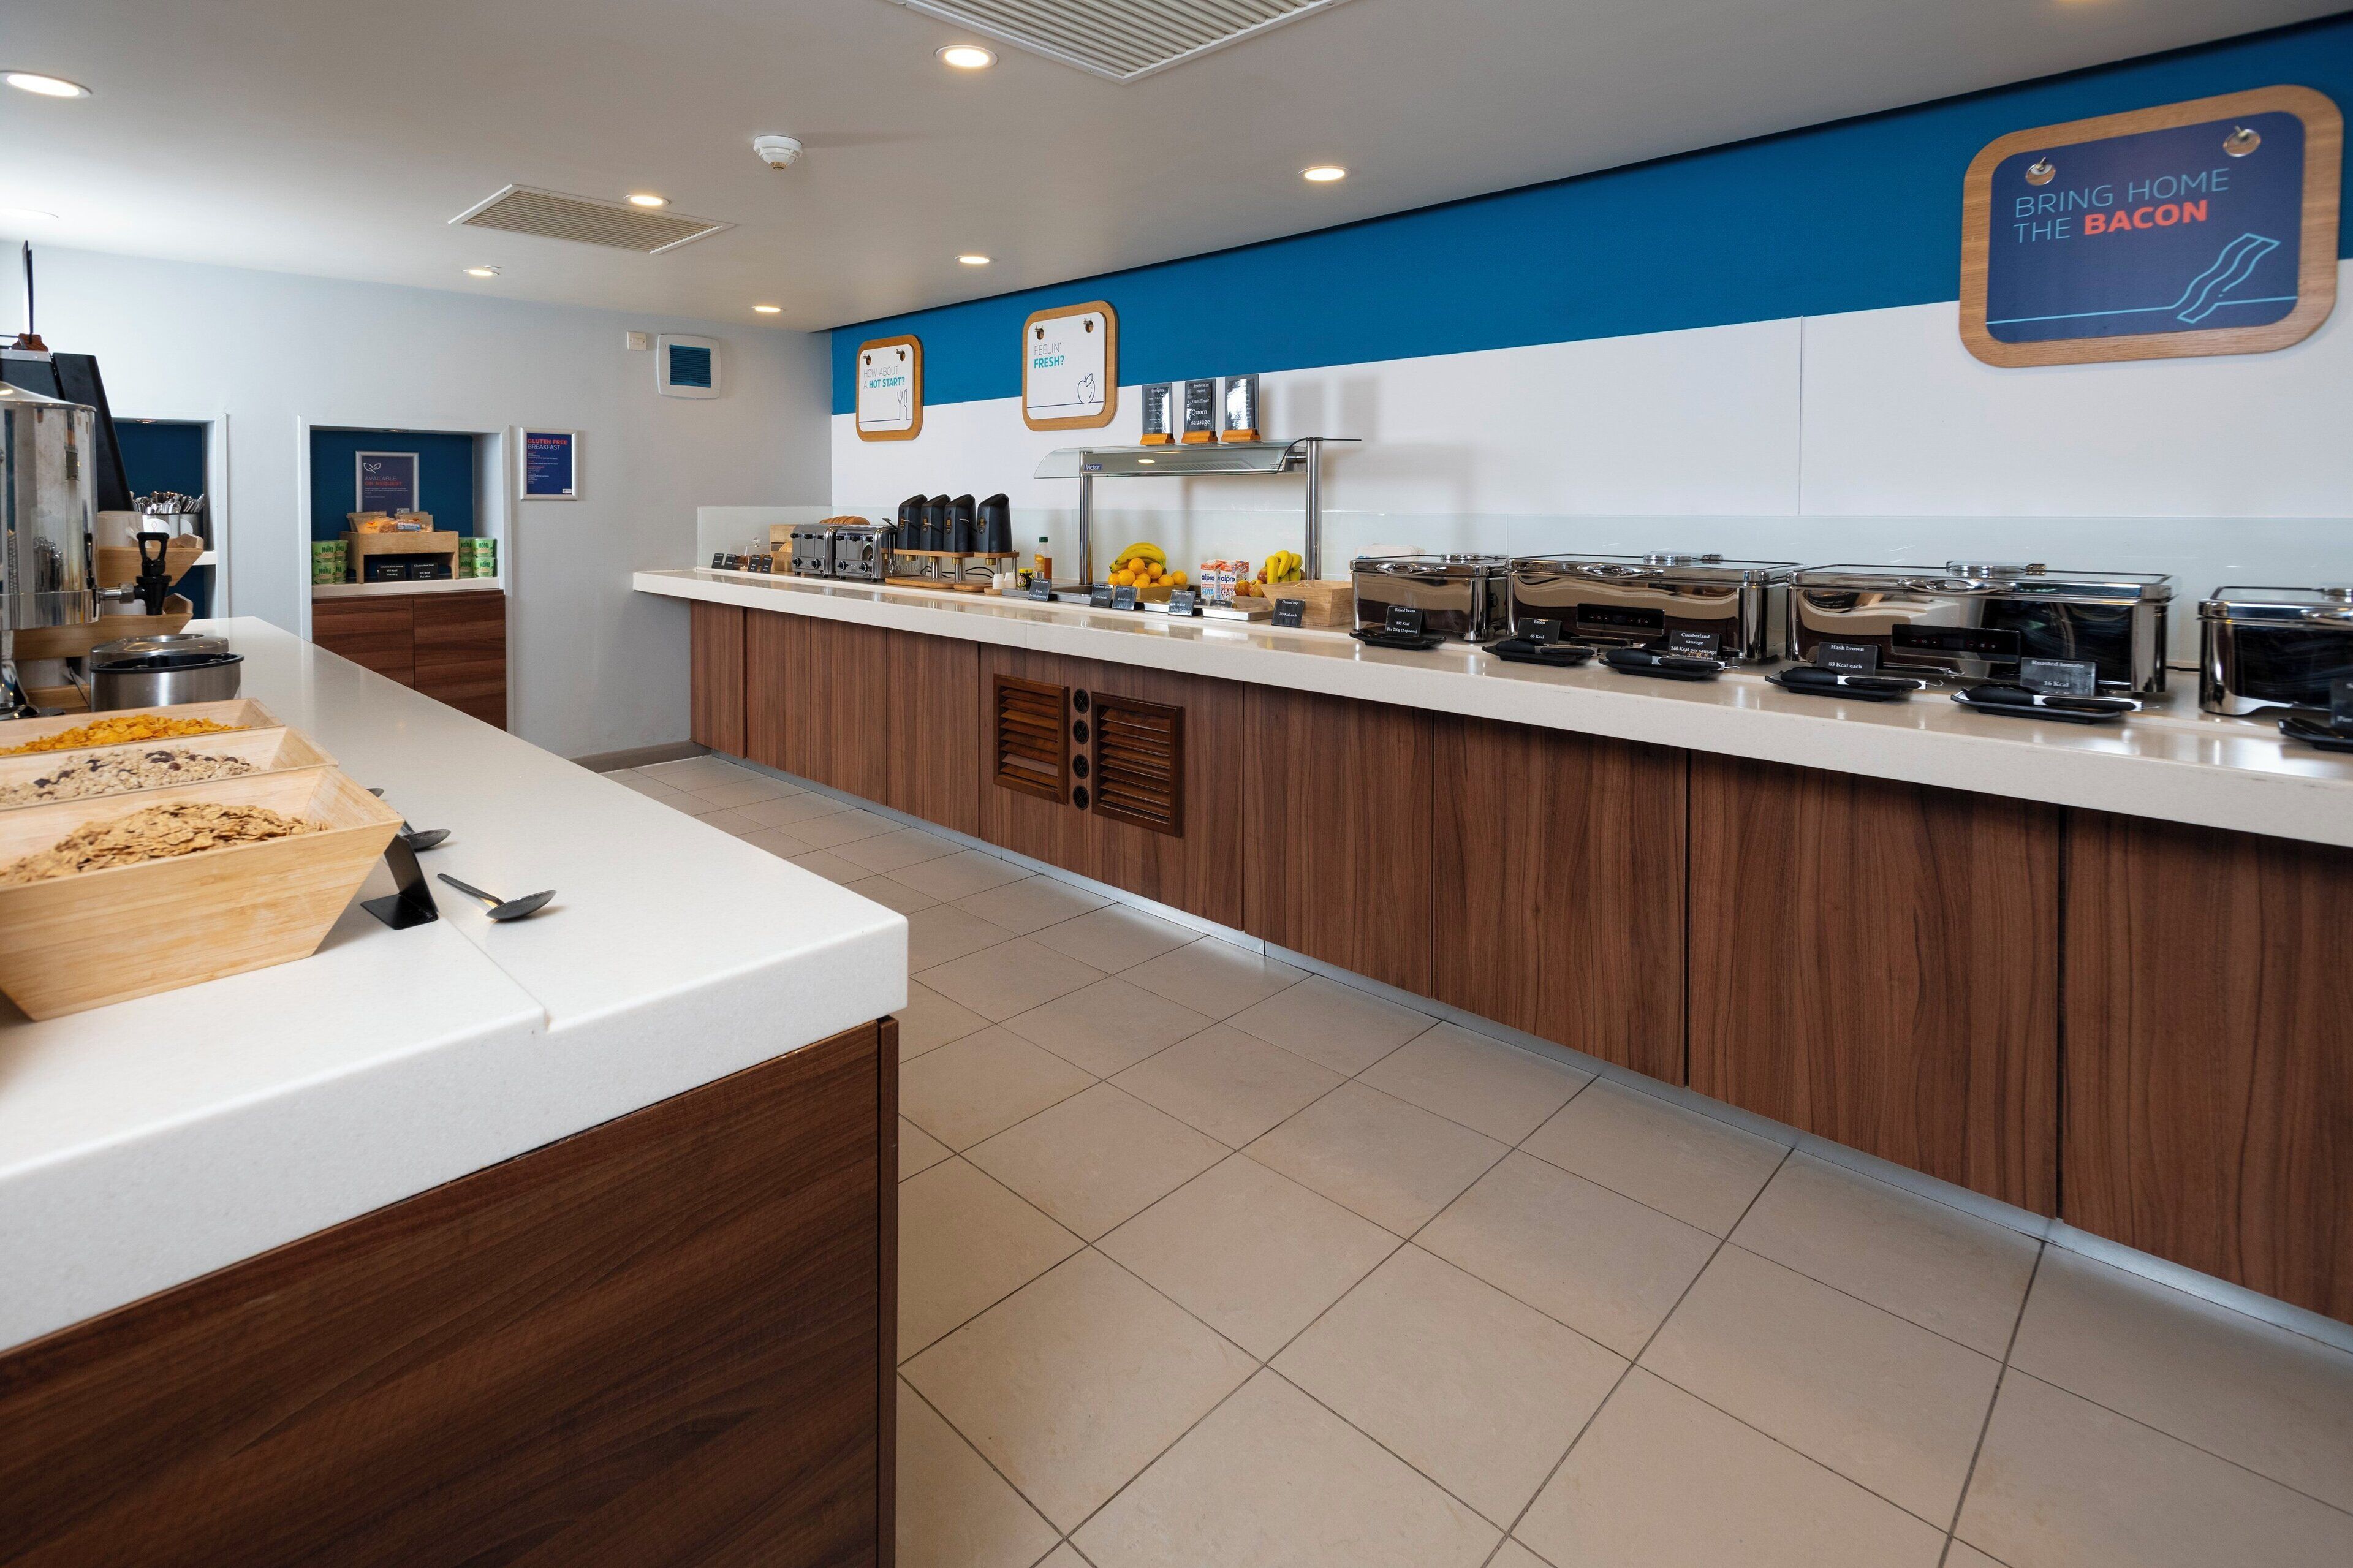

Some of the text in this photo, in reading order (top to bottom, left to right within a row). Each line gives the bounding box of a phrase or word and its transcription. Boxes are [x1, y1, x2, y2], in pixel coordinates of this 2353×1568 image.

[2015, 167, 2230, 218] BRING HOME
[2014, 199, 2208, 243] THE BACON
[1034, 342, 1061, 355] FEELIN'
[1034, 355, 1065, 369] FRESH?
[863, 365, 899, 378] HOW ABOUT
[863, 376, 905, 389] A HOT START?
[1201, 573, 1215, 582] alpro
[1221, 574, 1235, 583] alpro
